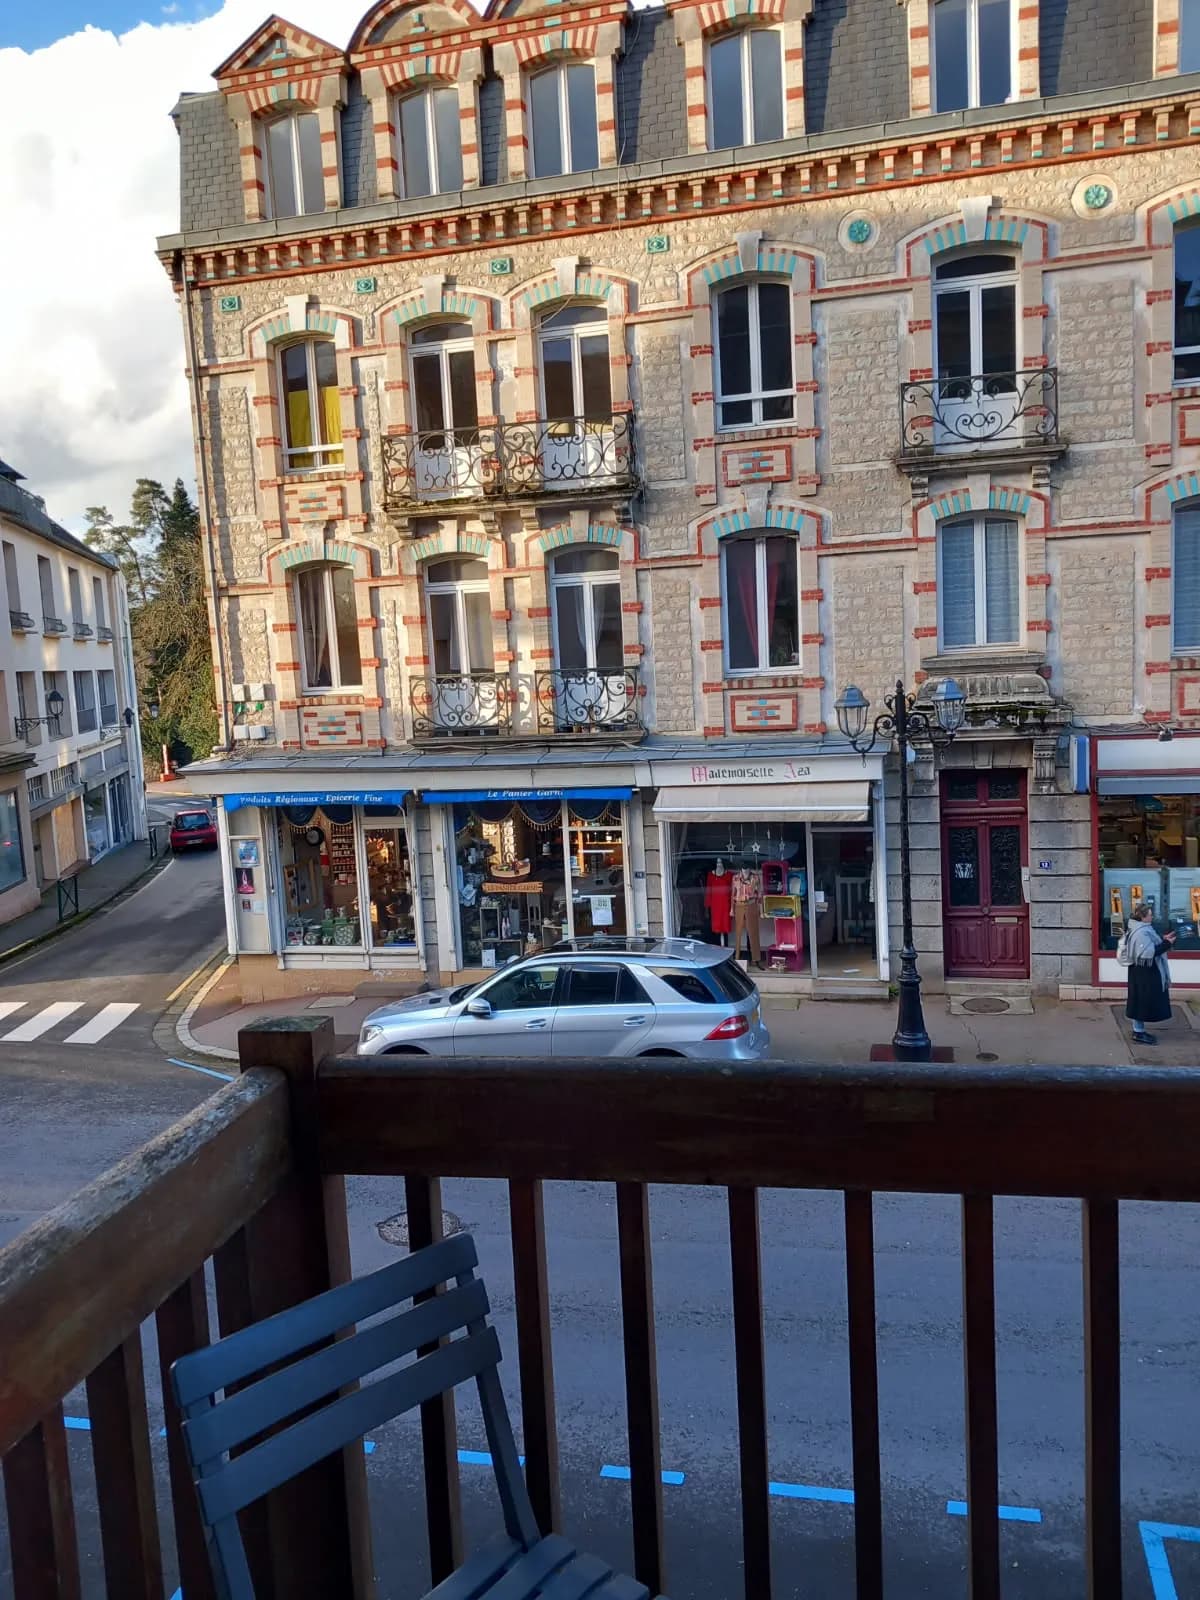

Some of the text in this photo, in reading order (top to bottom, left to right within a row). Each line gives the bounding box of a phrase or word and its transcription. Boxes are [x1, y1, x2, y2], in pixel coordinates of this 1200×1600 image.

[690, 765, 774, 782] Mademoiselle
[363, 793, 383, 802] Fine
[487, 790, 498, 798] Le
[502, 789, 534, 797] Panier
